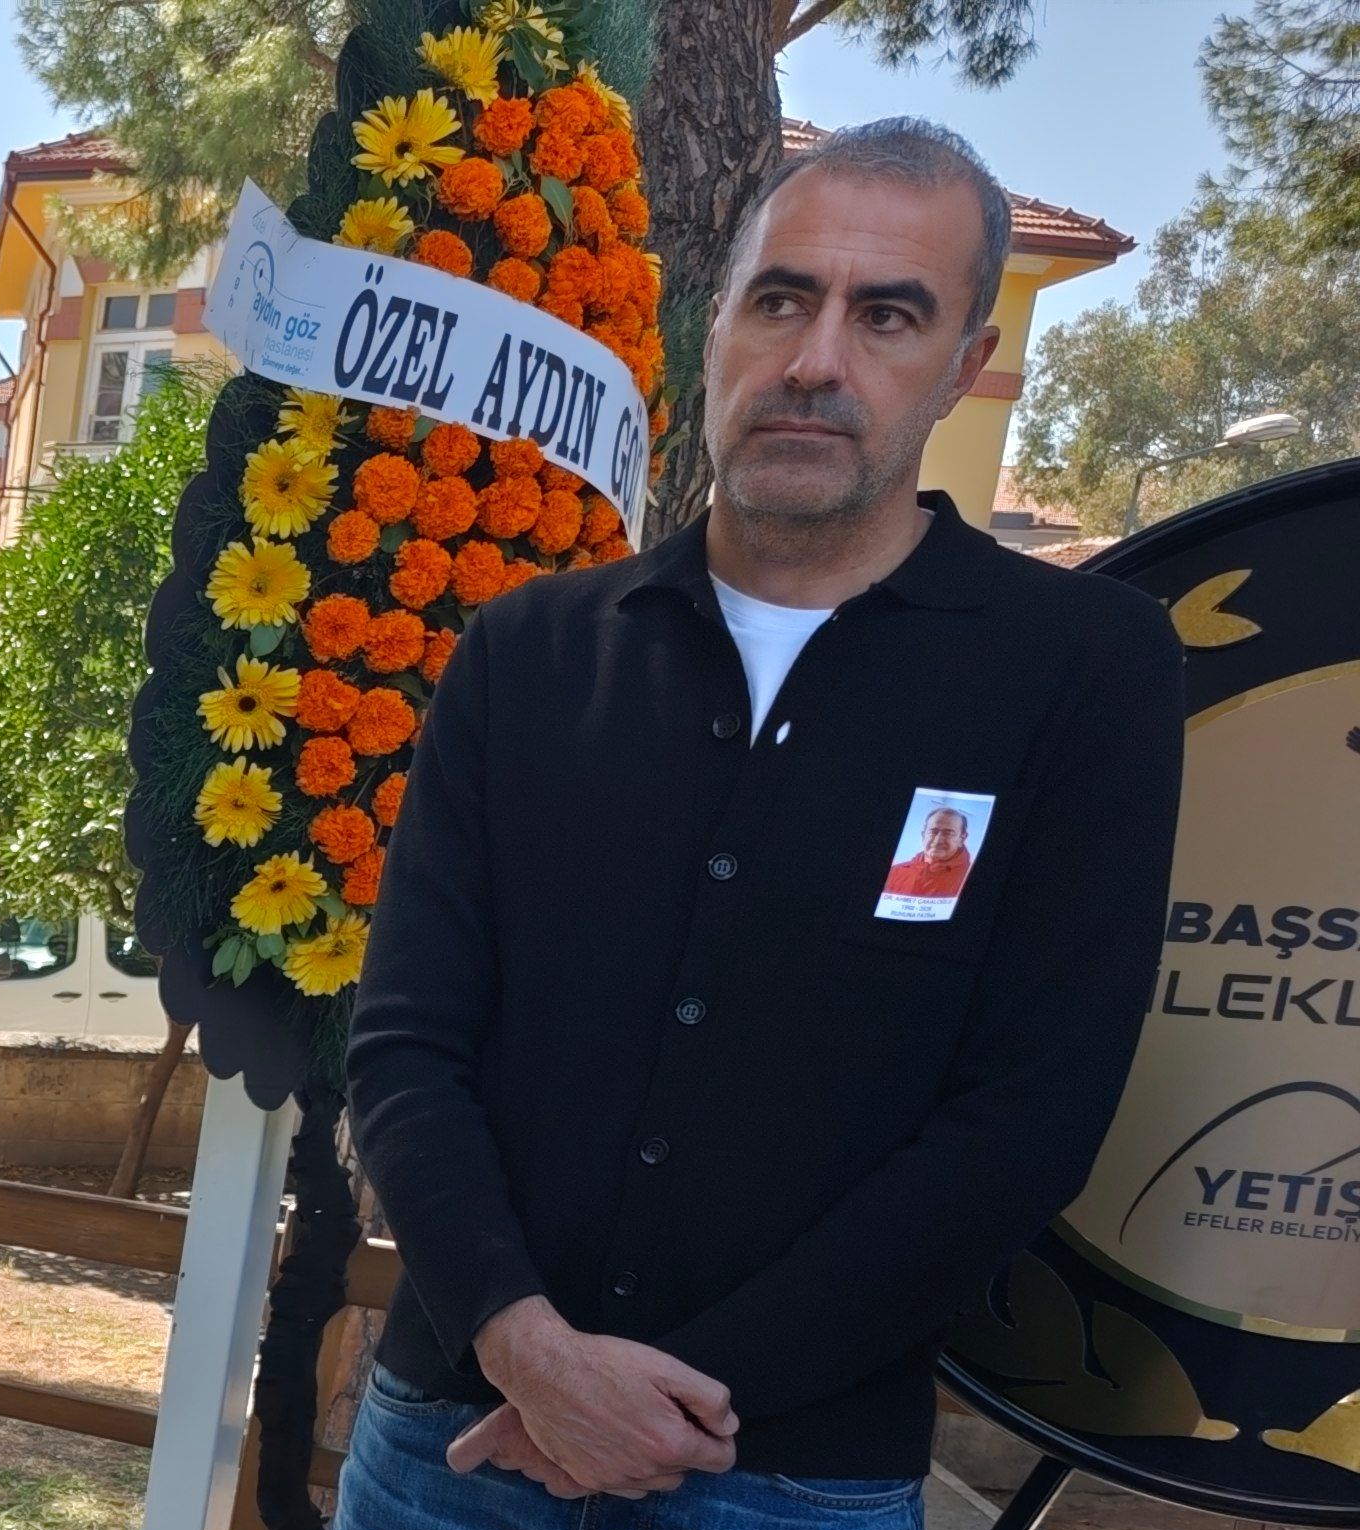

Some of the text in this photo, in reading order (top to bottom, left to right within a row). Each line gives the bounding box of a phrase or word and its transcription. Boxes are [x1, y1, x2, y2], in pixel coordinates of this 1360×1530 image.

[253, 292, 321, 342] aydın göz
[264, 335, 314, 362] hastanesi
[334, 262, 458, 411] ÖZEL
[471, 333, 606, 470] AYDIN
[1165, 901, 1360, 960] BAŞS
[1183, 1211, 1265, 1234] EFELER
